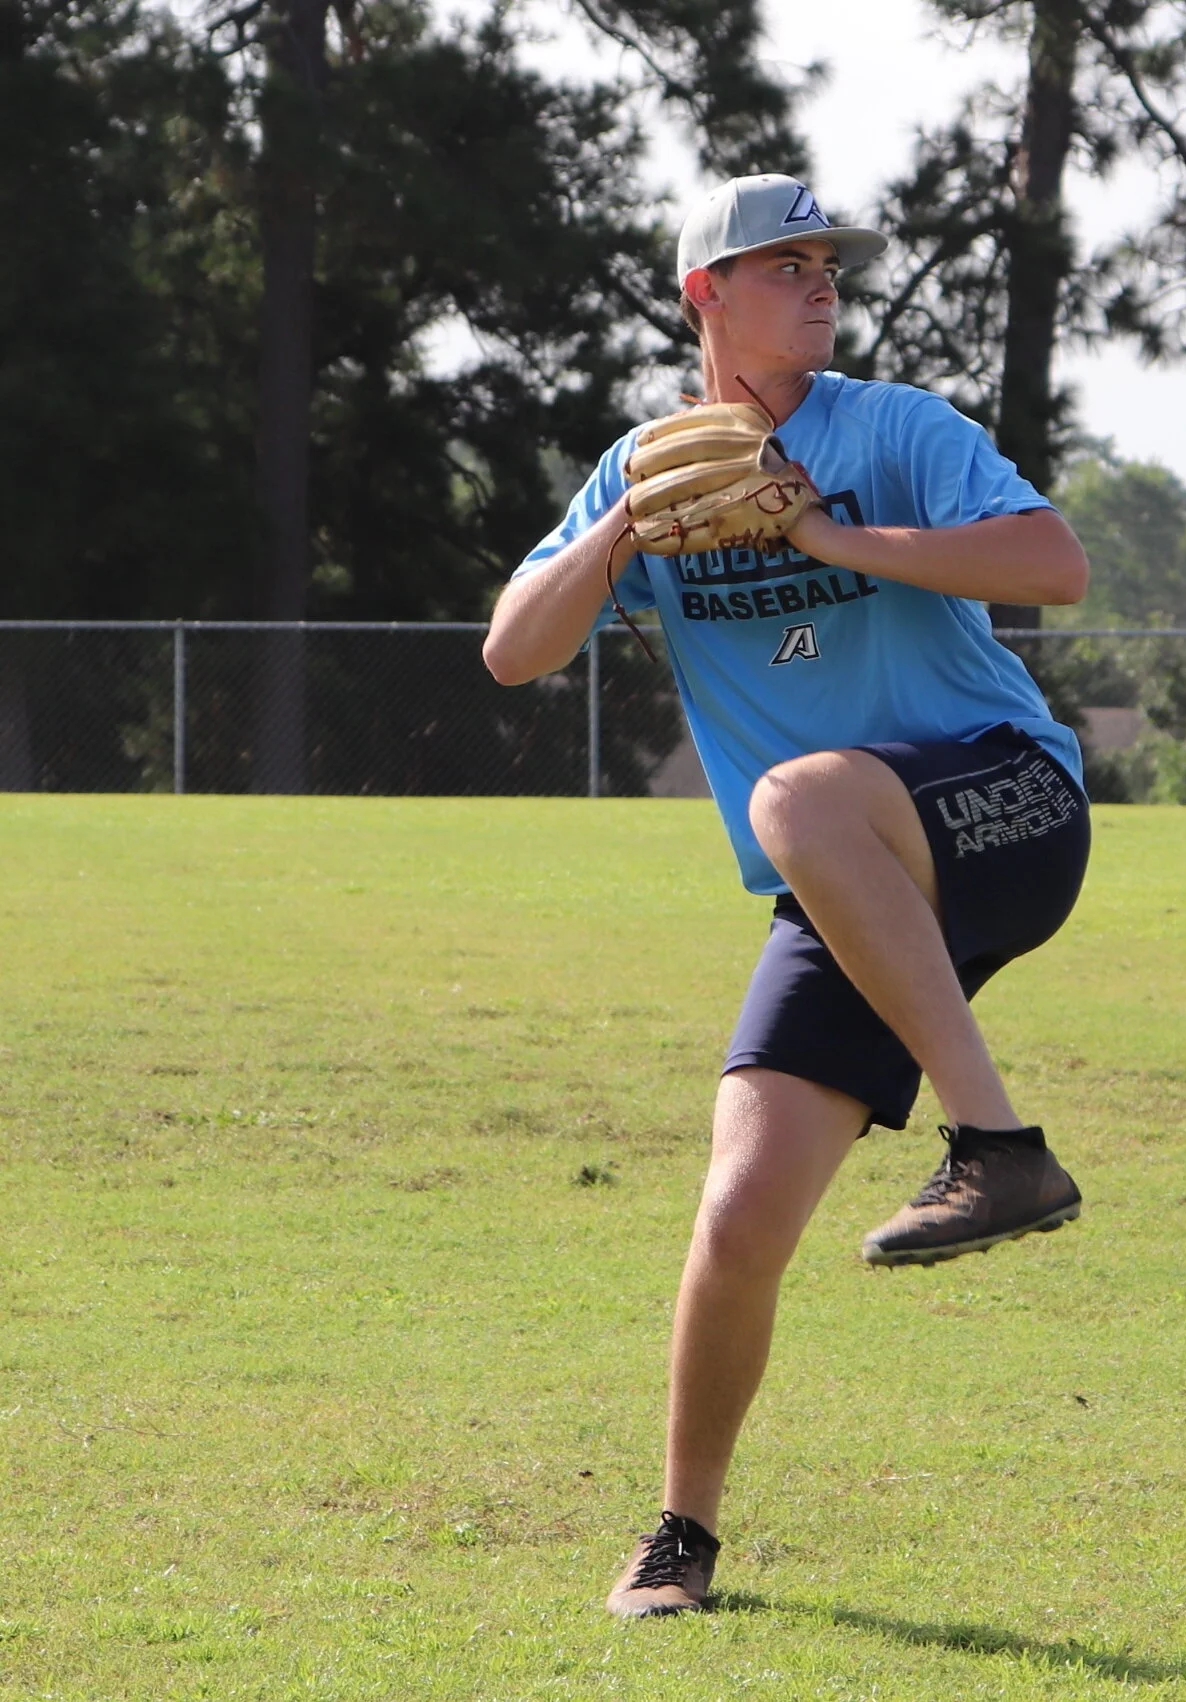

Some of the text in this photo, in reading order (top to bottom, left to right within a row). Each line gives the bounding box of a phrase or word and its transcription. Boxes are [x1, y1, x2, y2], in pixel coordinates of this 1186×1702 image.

[681, 573, 878, 621] BASEBALL
[769, 622, 821, 666] A
[936, 758, 1063, 830] UNDER
[956, 787, 1079, 859] ARMOUR
